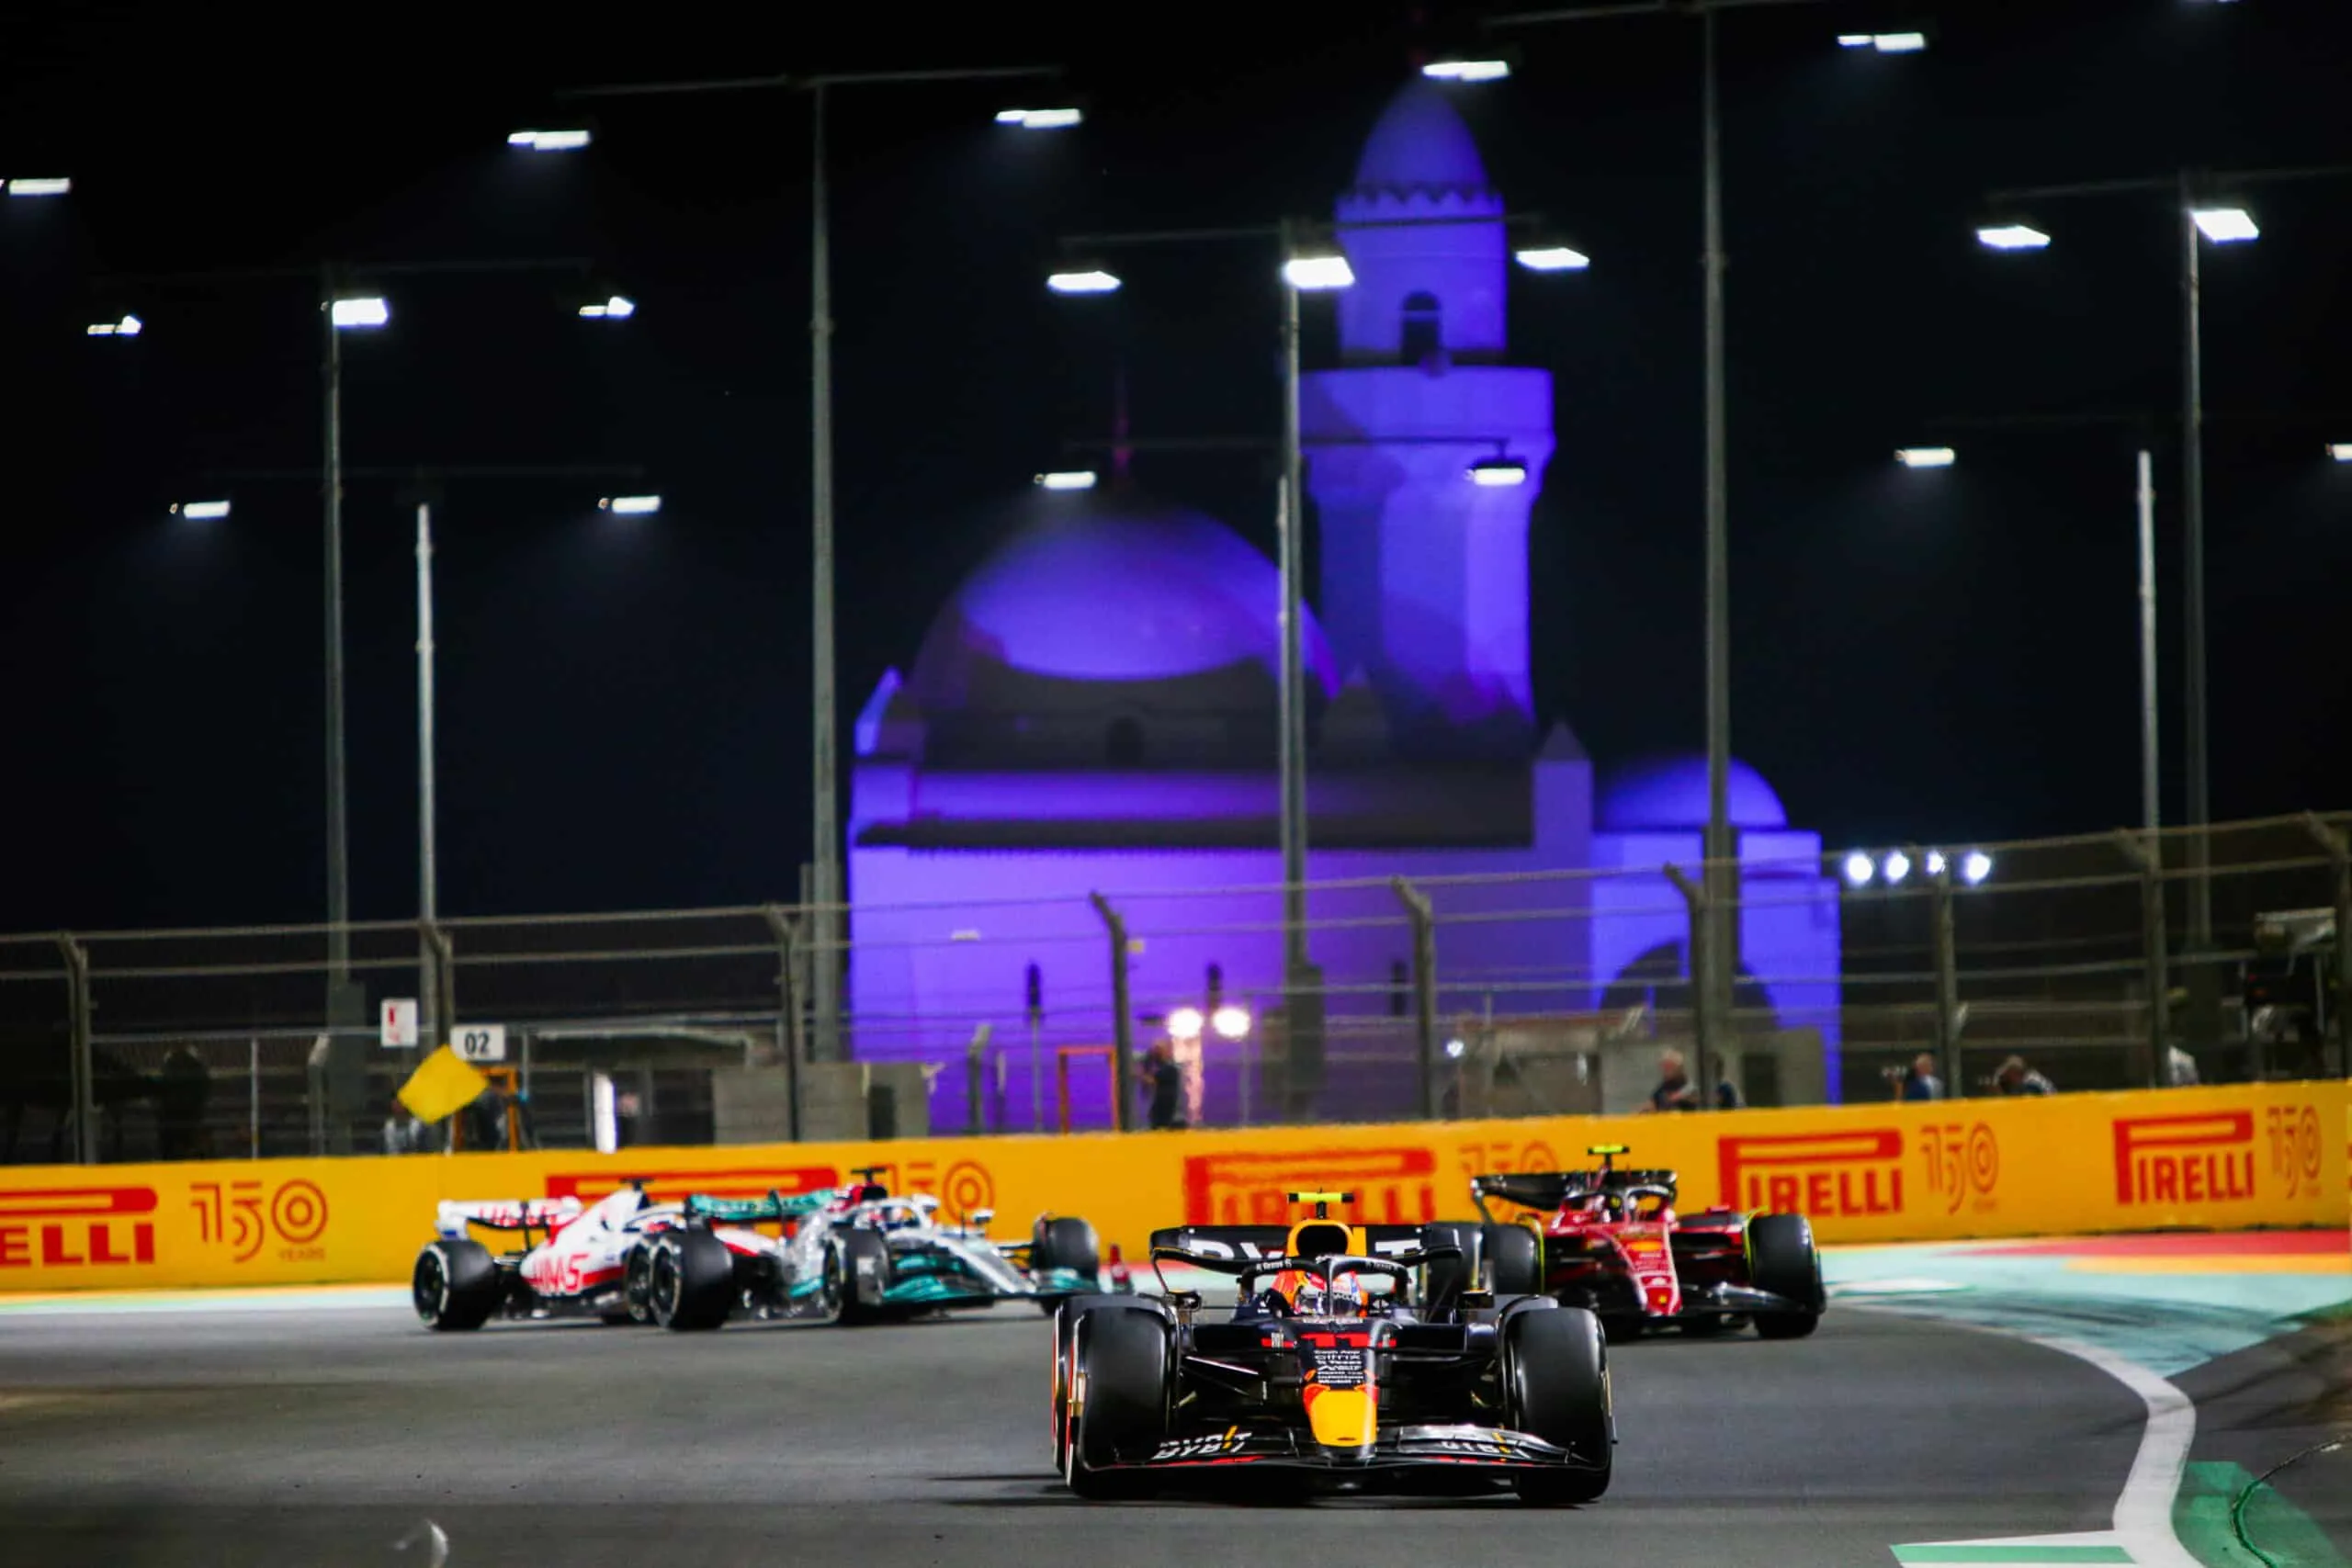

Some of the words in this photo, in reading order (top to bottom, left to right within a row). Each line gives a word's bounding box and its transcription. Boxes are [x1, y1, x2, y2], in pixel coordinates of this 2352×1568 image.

[465, 1032, 490, 1055] 02
[1183, 1147, 1437, 1226] PIRLLI
[1717, 1128, 1905, 1217] PIRELLI
[1919, 1122, 1999, 1215] 150
[2113, 1110, 2255, 1205] PIRELLI
[189, 1179, 328, 1264] 150
[1300, 1331, 1369, 1348] 11
